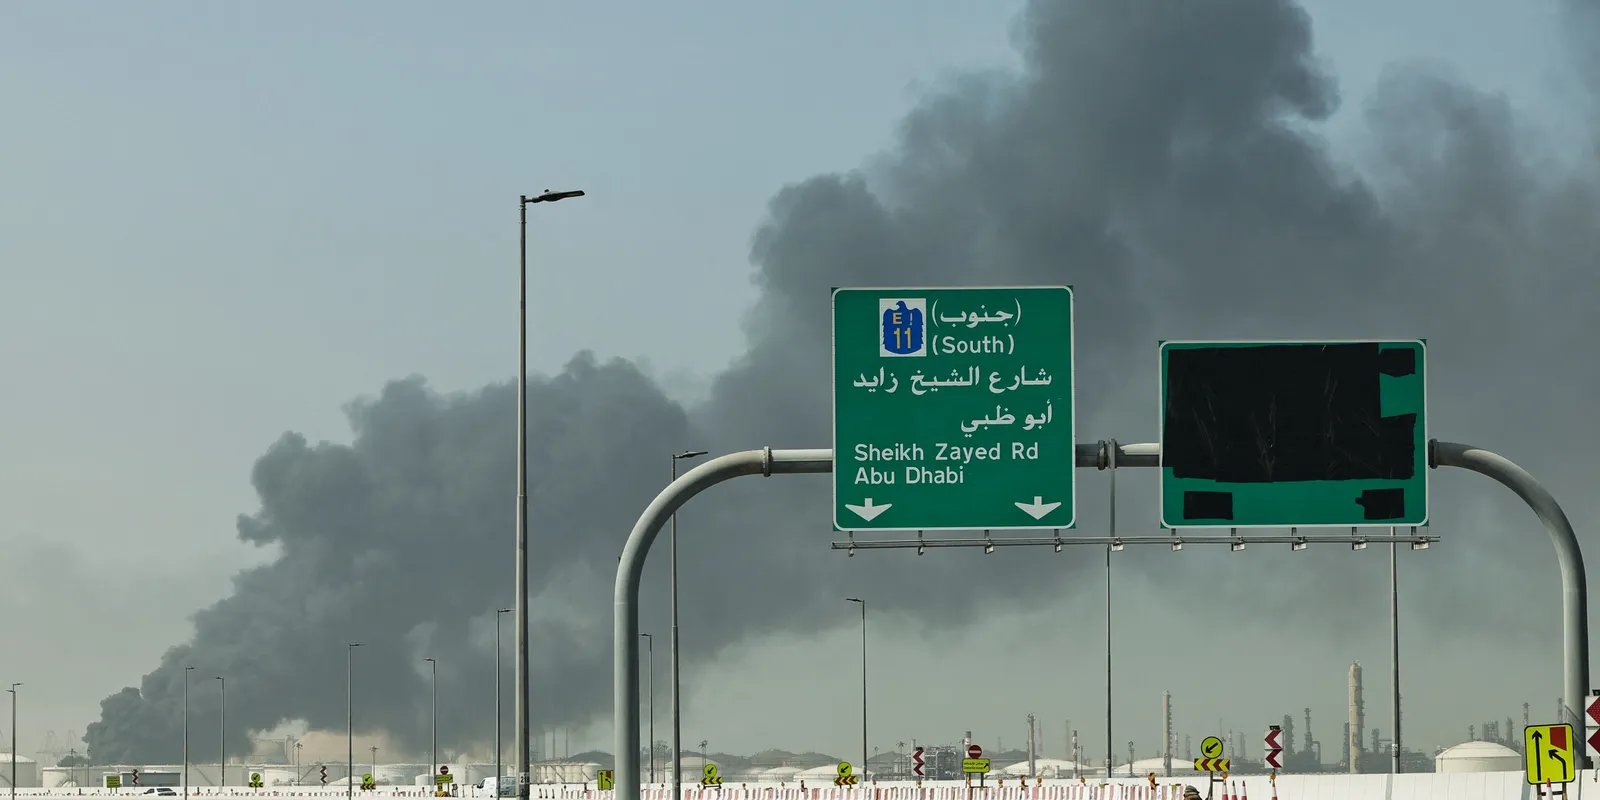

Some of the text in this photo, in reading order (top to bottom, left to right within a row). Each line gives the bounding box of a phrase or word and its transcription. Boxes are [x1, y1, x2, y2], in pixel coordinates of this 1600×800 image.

[892, 312, 902, 325] E
[932, 298, 1021, 328] (جنوب)
[893, 327, 912, 349] 11
[932, 334, 1015, 356] (South)
[853, 366, 1053, 395] شارع الشيخ زايد
[961, 399, 1053, 438] أبو ظبي
[854, 442, 1039, 464] Sheikh Zayed Rd
[854, 466, 964, 485] Abu Dhabi
